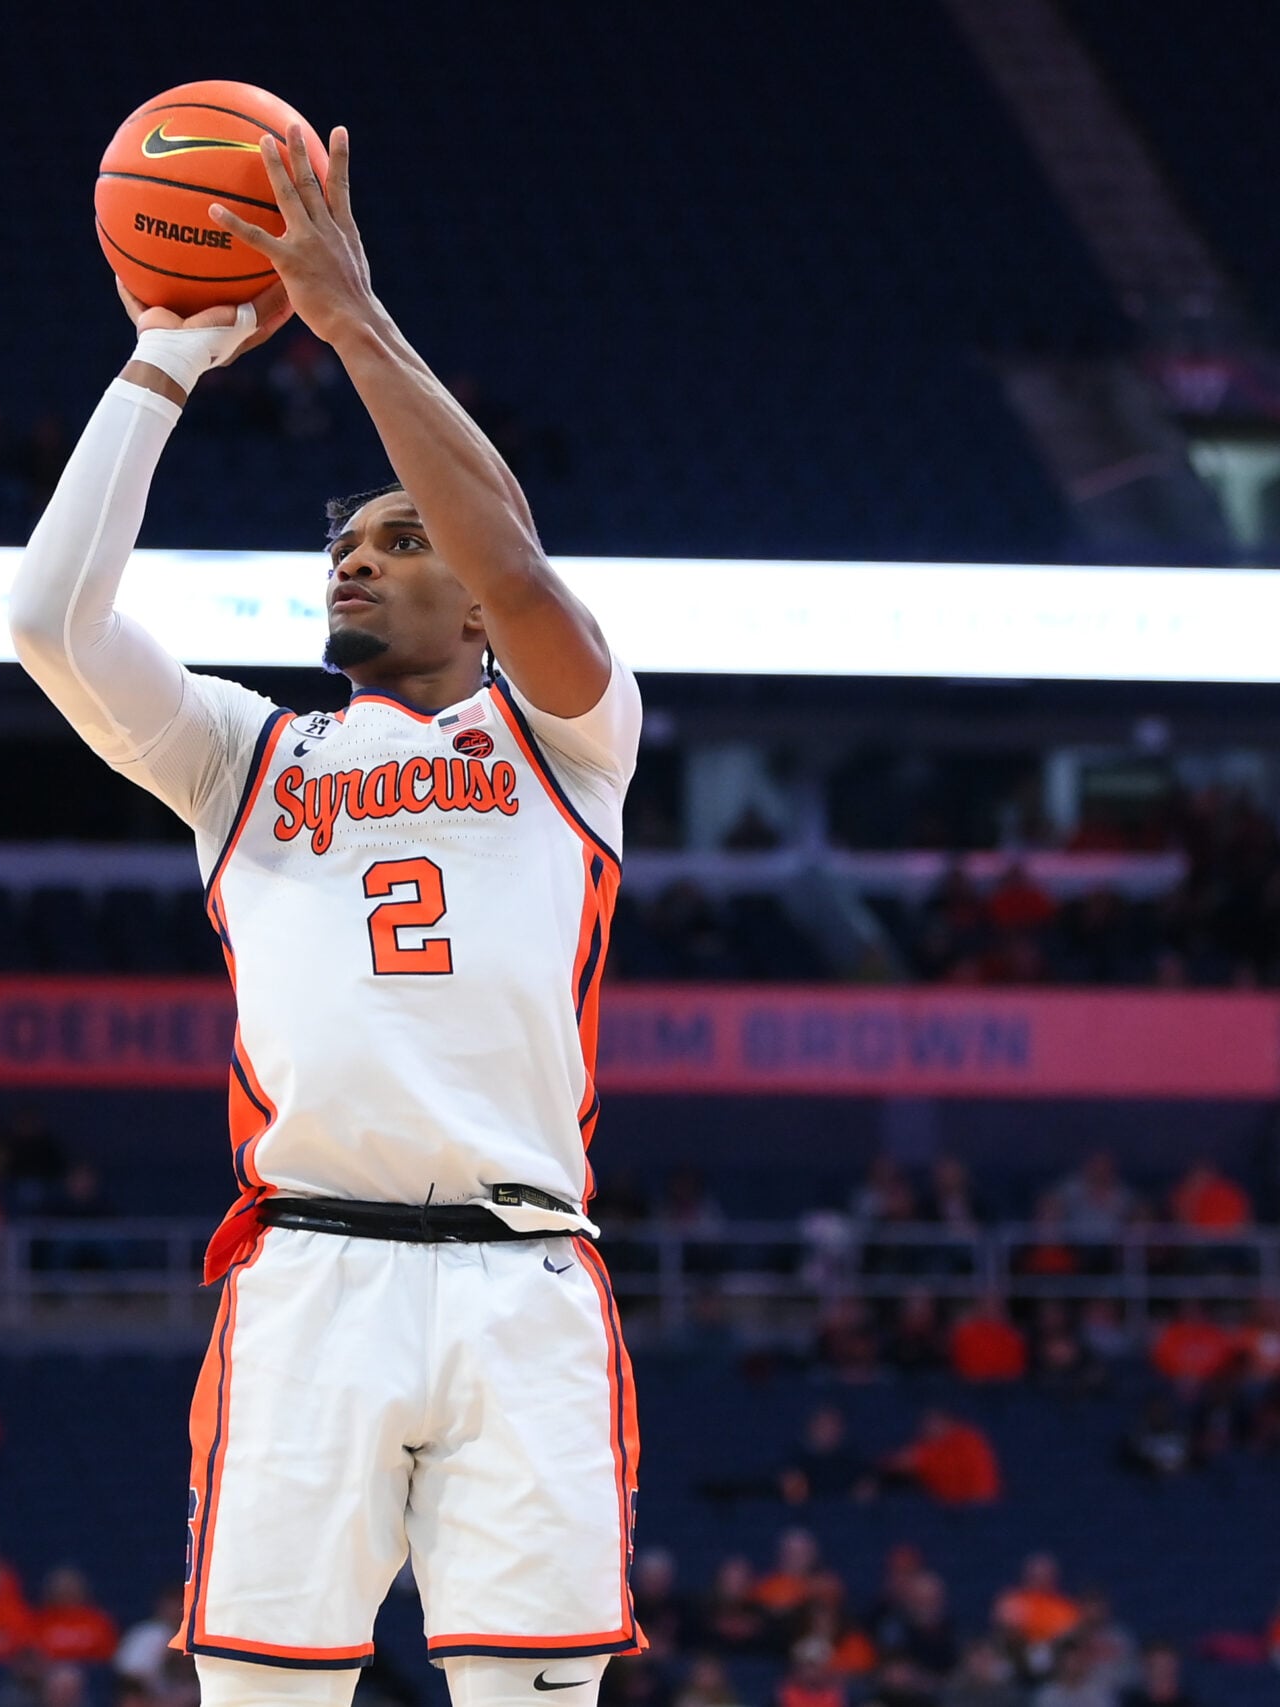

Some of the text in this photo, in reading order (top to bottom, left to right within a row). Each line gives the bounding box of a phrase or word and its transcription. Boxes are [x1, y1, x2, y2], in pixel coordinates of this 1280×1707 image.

[133, 213, 233, 251] SYRACUSE
[305, 723, 326, 736] 21
[273, 756, 519, 856] Syracuse
[362, 856, 454, 976] 2
[742, 1007, 1031, 1069] BROWN
